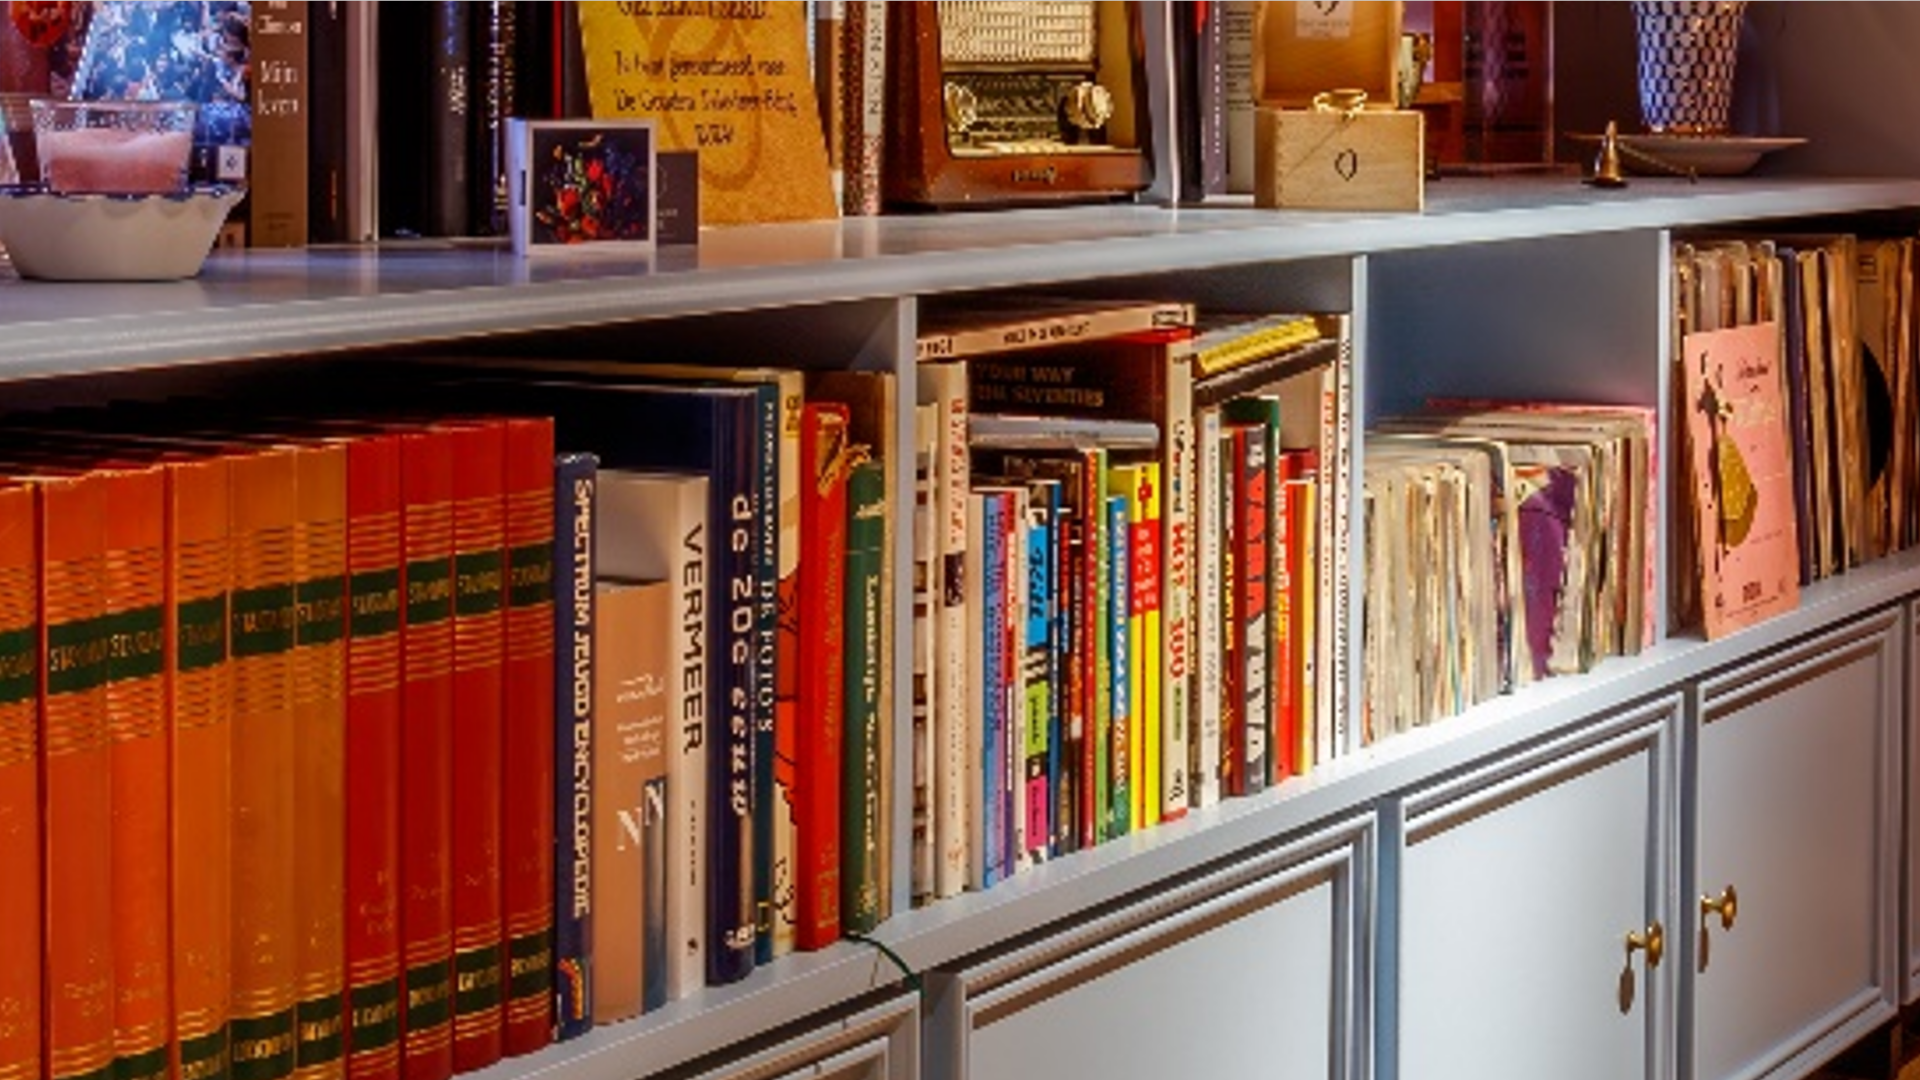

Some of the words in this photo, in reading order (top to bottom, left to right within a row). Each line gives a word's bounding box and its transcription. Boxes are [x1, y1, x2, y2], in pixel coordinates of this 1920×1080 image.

[1011, 386, 1105, 408] SEVENTIES
[1030, 366, 1075, 383] WAY
[574, 480, 594, 624] SPECTRUM
[731, 495, 753, 552] de
[683, 524, 703, 753] VERMEER
[760, 580, 776, 619] DE
[574, 632, 592, 716] JEUGD
[758, 631, 775, 732] FOTO'S
[730, 687, 750, 815] eeuw
[572, 720, 592, 918] ENCYCLOPEDIE
